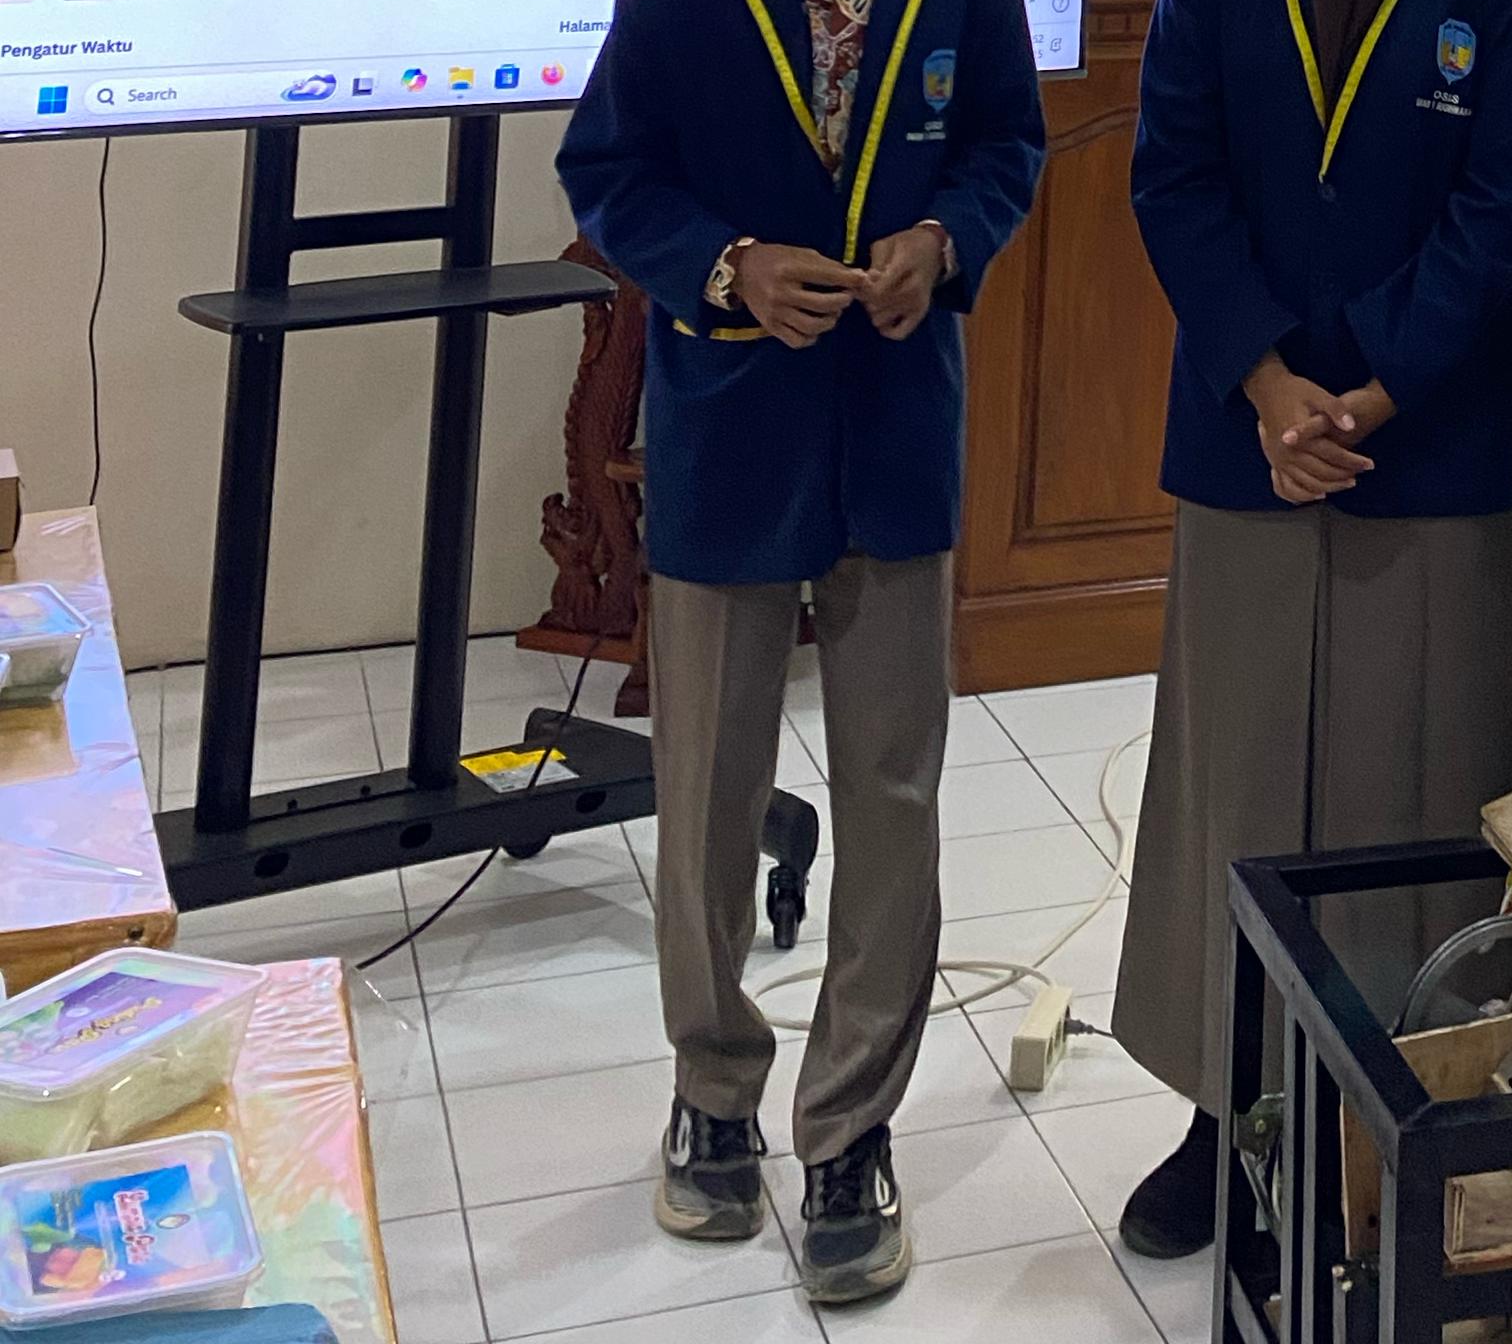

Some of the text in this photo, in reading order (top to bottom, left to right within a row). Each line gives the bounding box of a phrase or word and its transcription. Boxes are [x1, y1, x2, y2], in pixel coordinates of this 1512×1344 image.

[1, 40, 132, 59] Pengatur Waktu
[128, 88, 177, 102] Search
